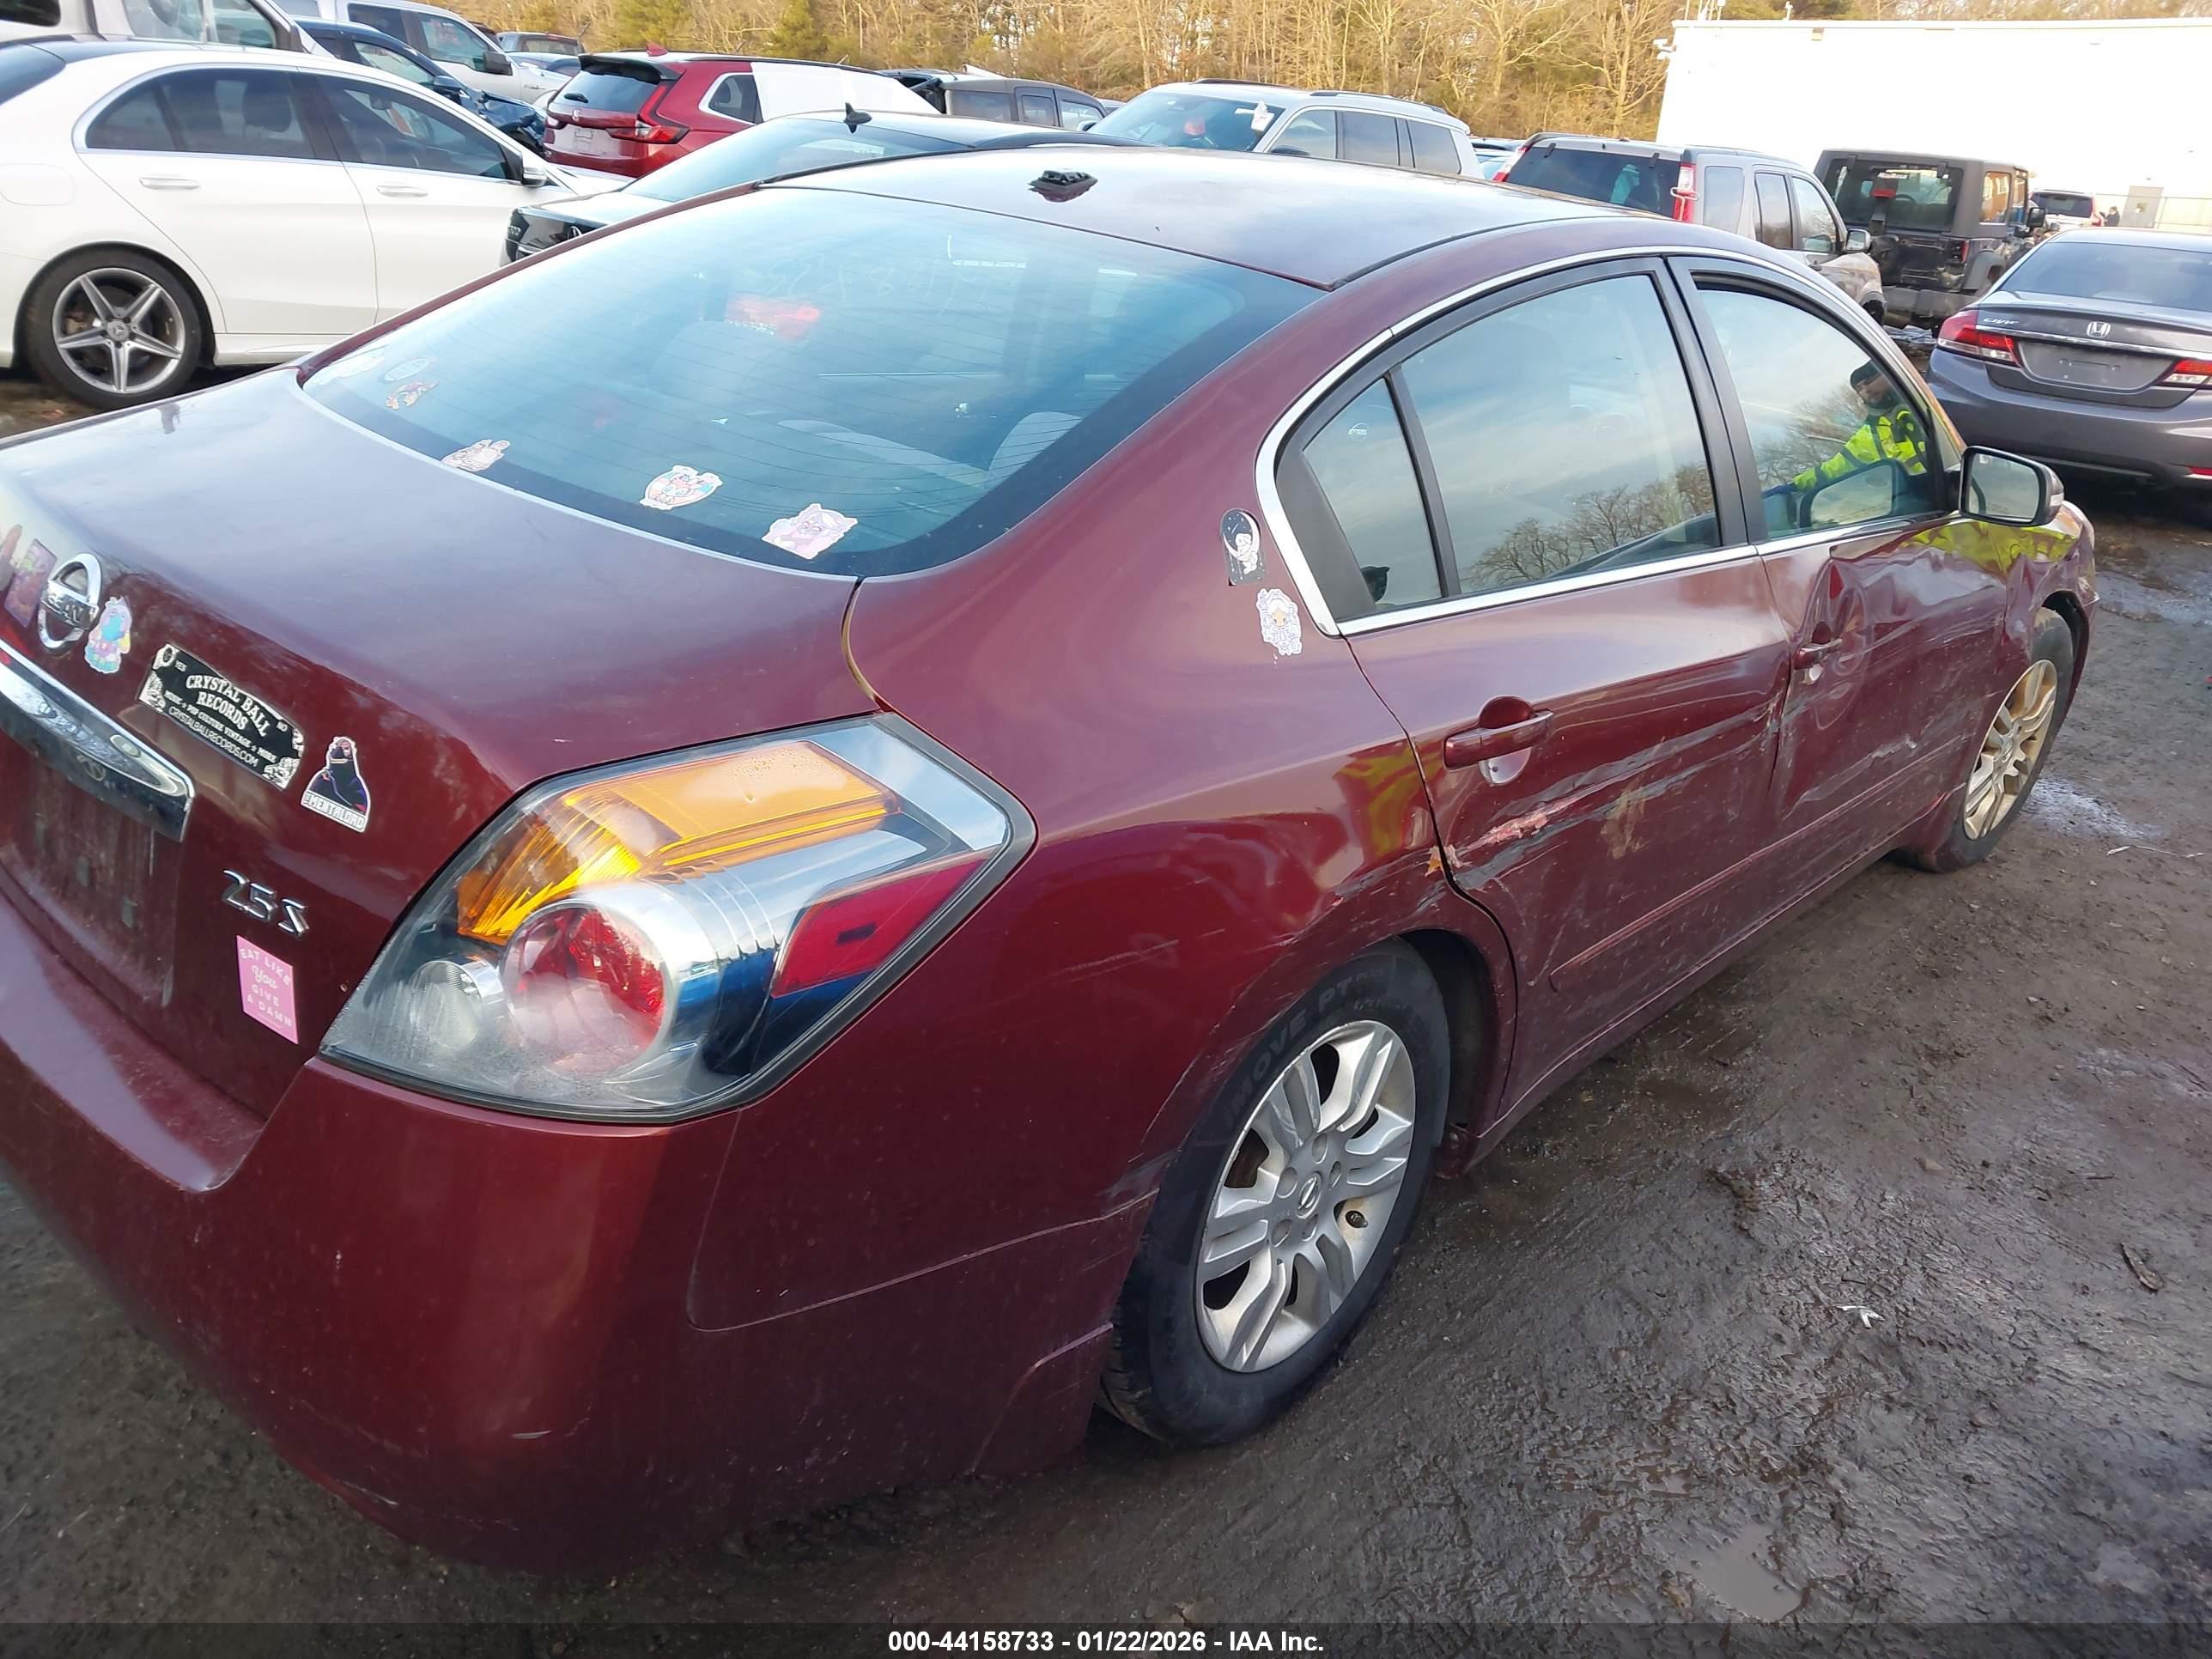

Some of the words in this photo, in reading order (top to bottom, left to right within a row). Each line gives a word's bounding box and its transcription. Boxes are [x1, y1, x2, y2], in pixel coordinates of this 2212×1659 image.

[1983, 317, 2020, 325] CIVIC
[174, 659, 188, 672] YES
[185, 674, 241, 702] CRYSTAL
[241, 696, 270, 737] BALL
[196, 691, 248, 730] RECORDS
[168, 706, 259, 768] CRYSTALBALLRECORDS.COM
[277, 897, 309, 939] S
[240, 948, 260, 960] EAT
[246, 994, 254, 1004] A
[258, 1000, 293, 1027] DAMN
[251, 984, 279, 1006] GIVE
